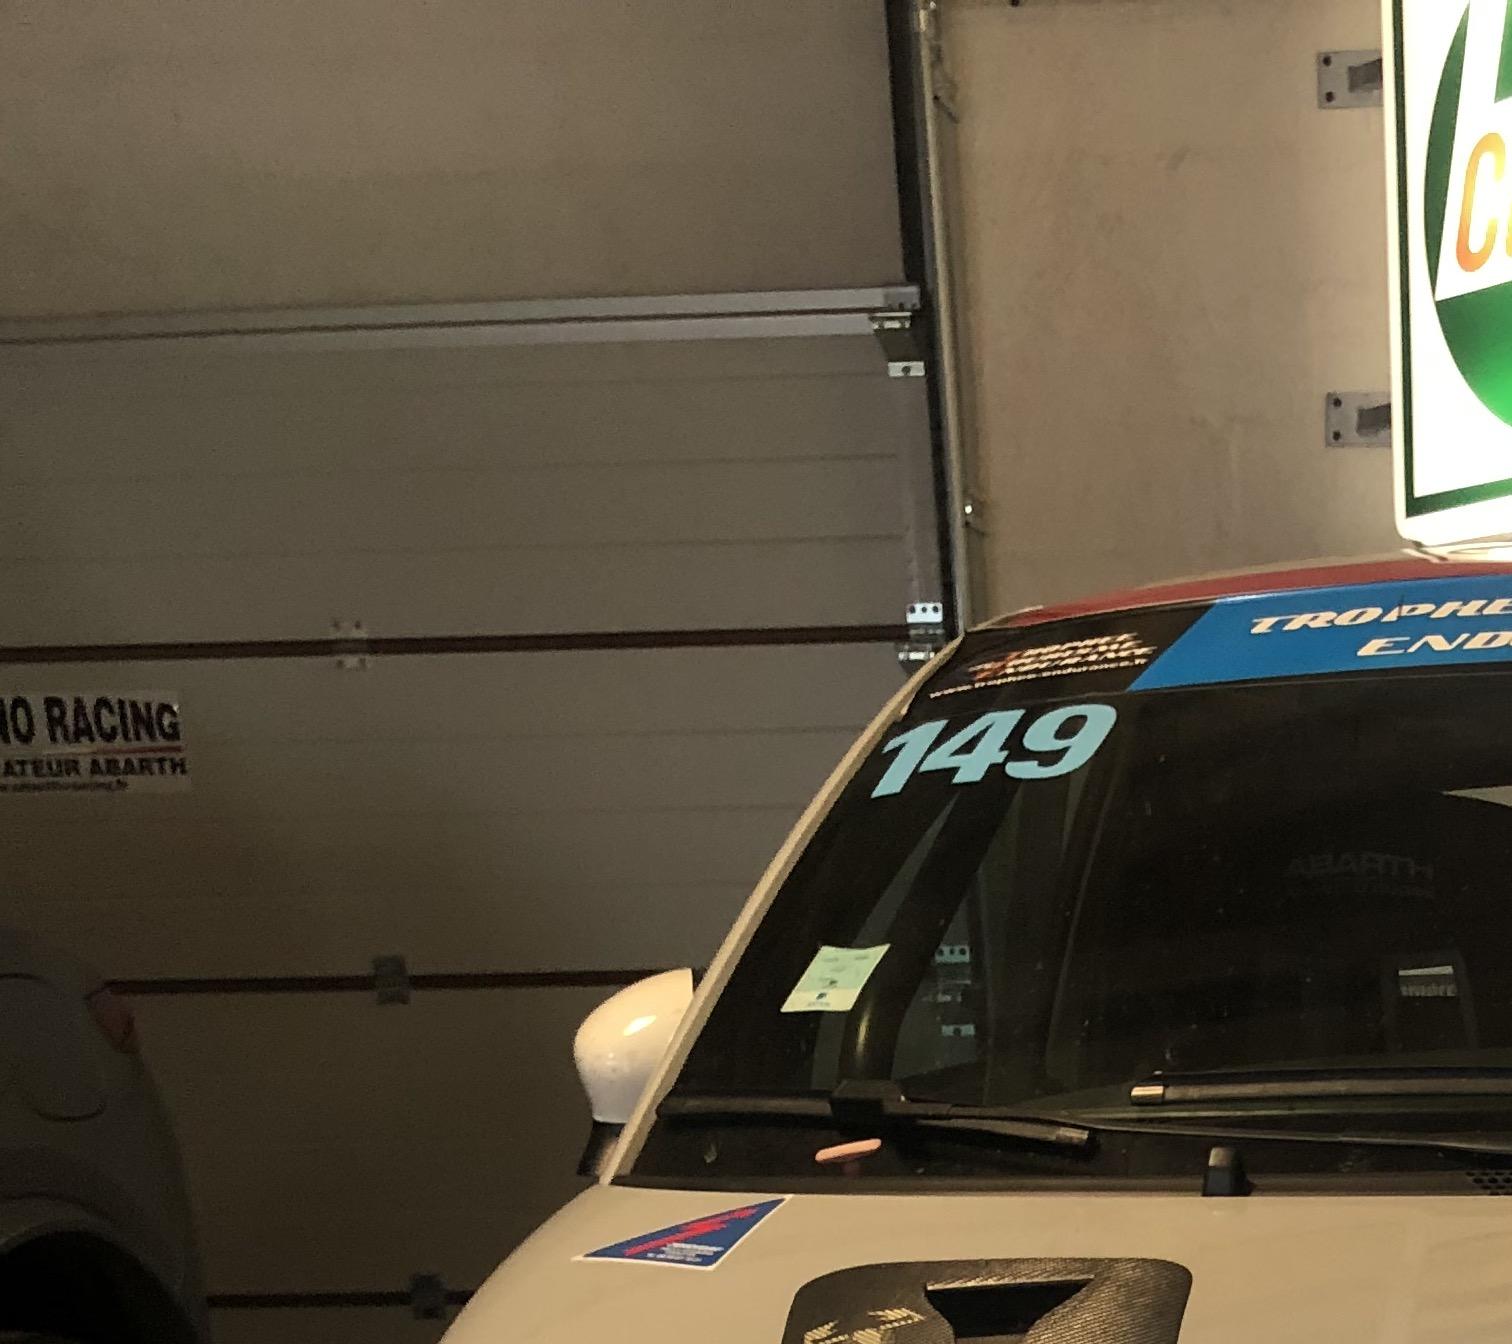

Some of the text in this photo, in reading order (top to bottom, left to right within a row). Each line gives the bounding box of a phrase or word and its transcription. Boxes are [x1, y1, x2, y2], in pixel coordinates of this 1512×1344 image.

[43, 695, 182, 744] RACING
[2, 756, 188, 778] ATEUR ABARTH
[871, 703, 1117, 799] 149
